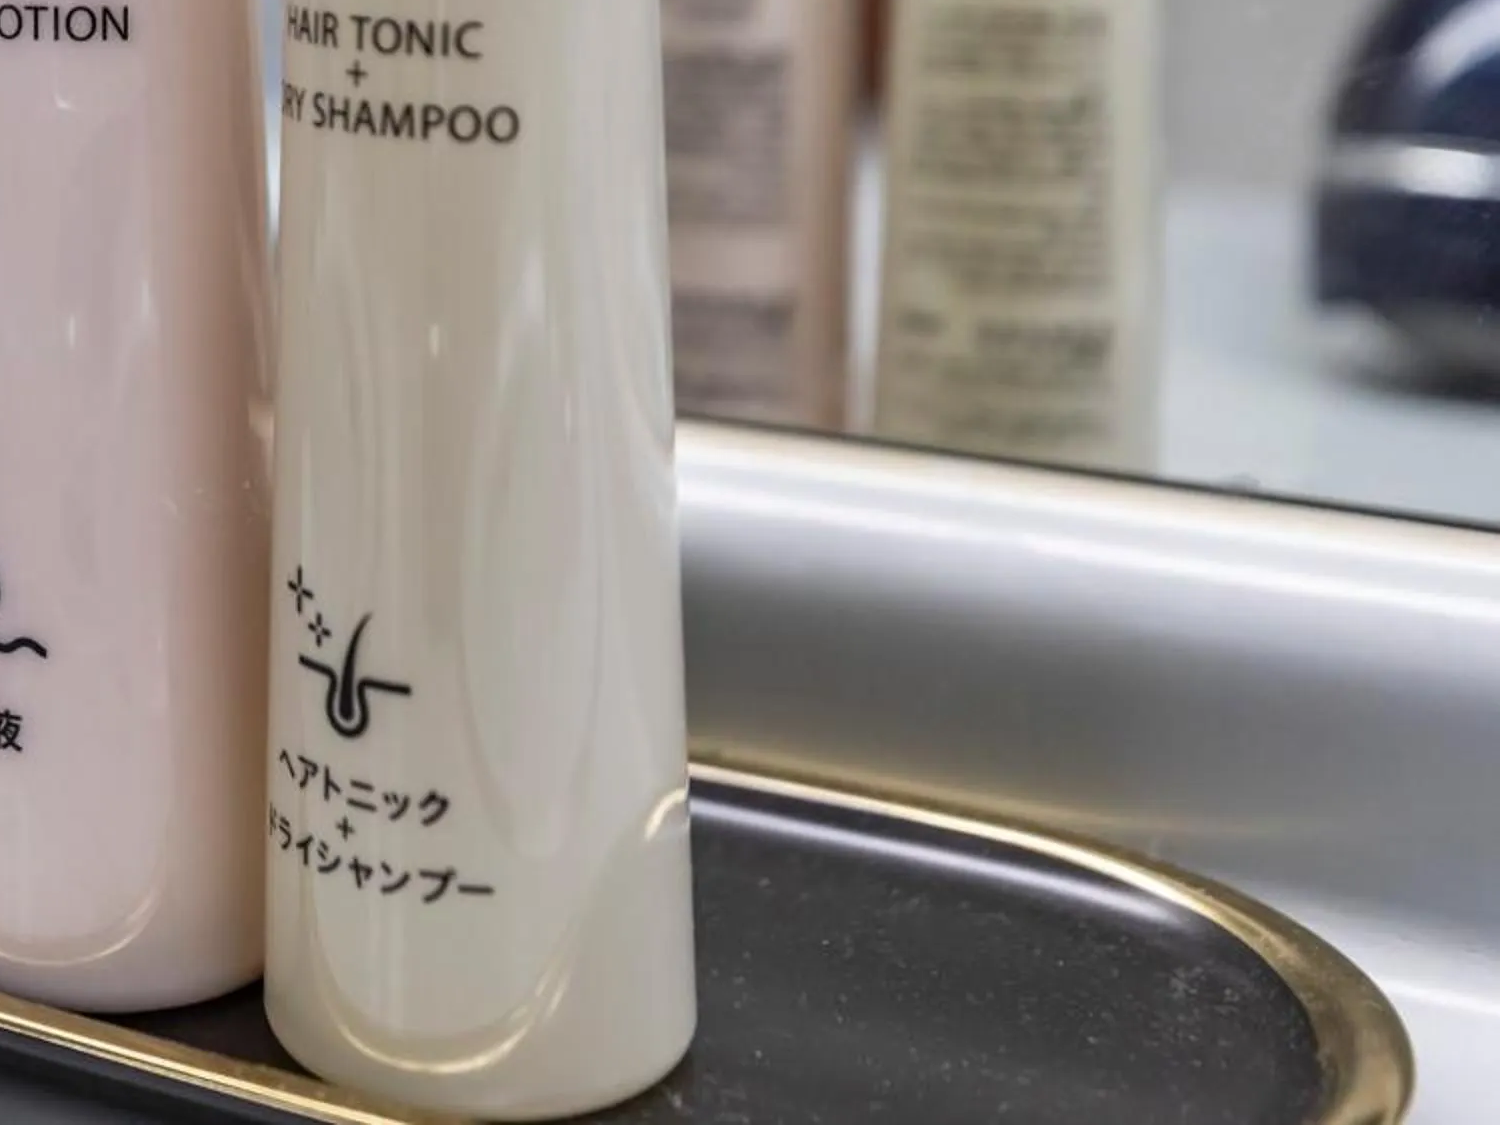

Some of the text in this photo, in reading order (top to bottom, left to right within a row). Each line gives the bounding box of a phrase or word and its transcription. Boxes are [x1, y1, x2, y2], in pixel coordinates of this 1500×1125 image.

[287, 5, 483, 59] HAIR TONIC
[312, 91, 520, 145] SHAMPOO
[280, 749, 450, 827] ヘアトニック
